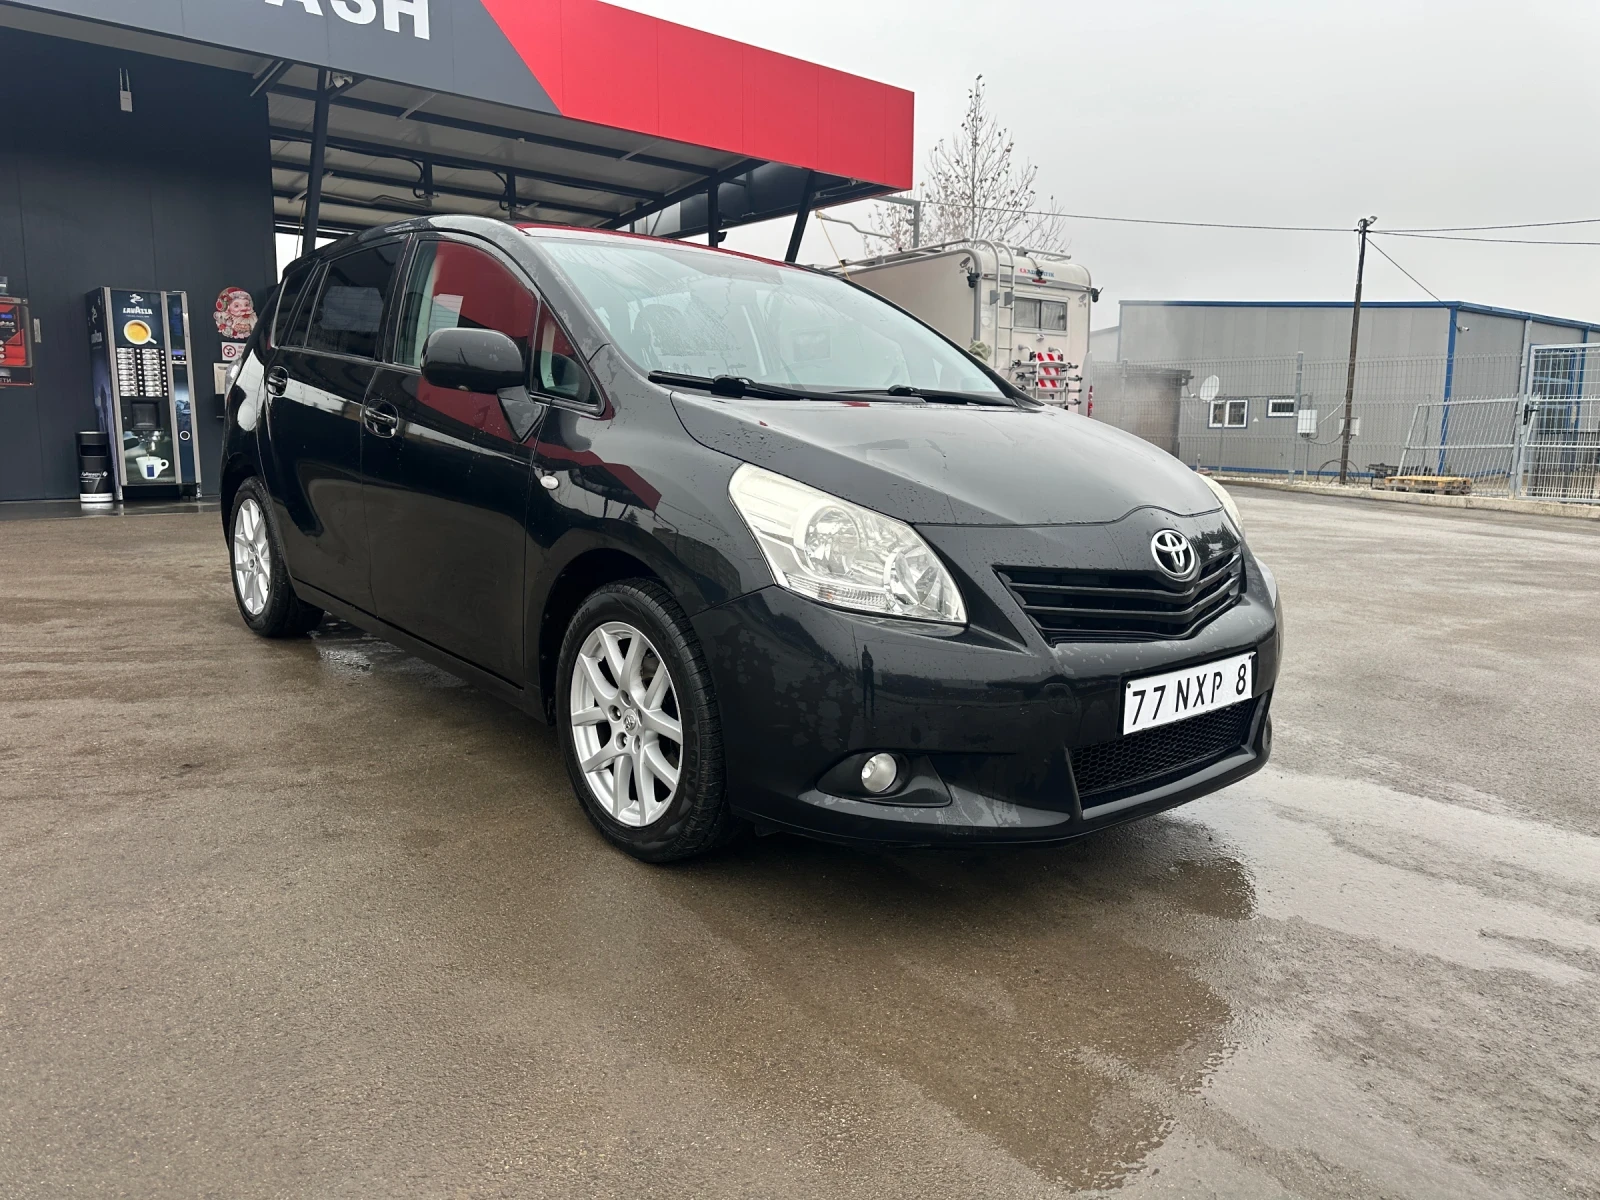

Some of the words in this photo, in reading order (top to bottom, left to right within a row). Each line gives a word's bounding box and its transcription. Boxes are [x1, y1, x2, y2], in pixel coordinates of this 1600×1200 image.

[123, 306, 153, 315] LAVAZZA
[1132, 684, 1167, 726] 77
[1175, 671, 1223, 713] NXP
[1235, 663, 1247, 695] 8
